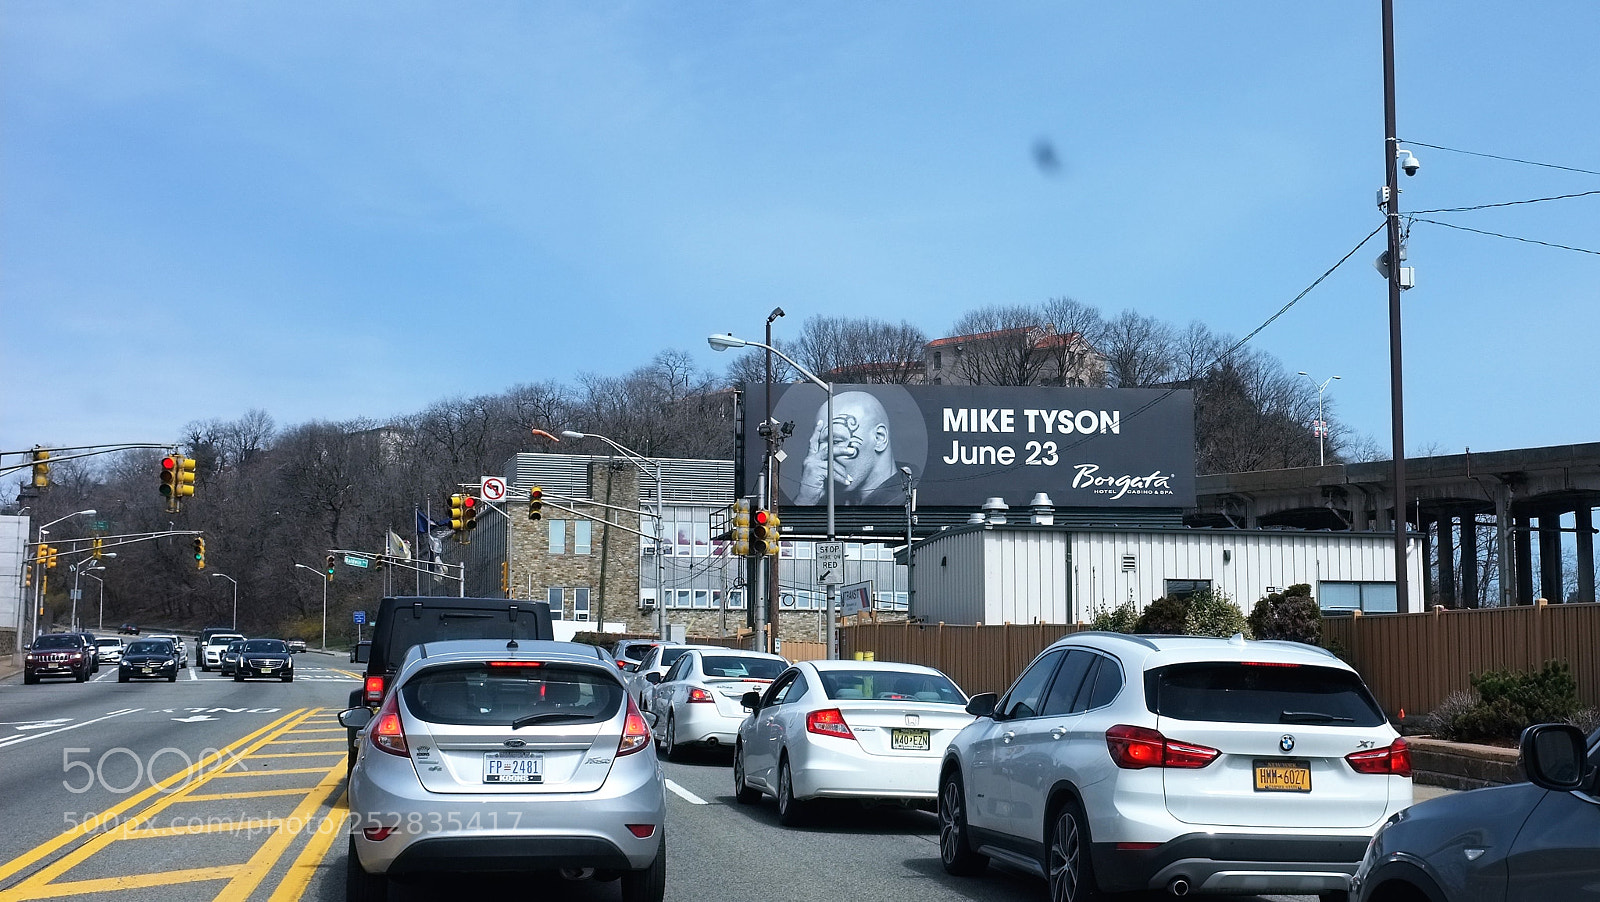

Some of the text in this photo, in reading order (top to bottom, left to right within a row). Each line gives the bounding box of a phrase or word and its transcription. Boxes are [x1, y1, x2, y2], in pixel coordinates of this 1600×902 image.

[943, 408, 1120, 435] MIKE TYSON
[942, 440, 1059, 466] June 23
[1072, 463, 1171, 500] Borgata
[820, 545, 840, 553] STOP
[822, 561, 838, 569] RED
[1356, 740, 1375, 749] X1
